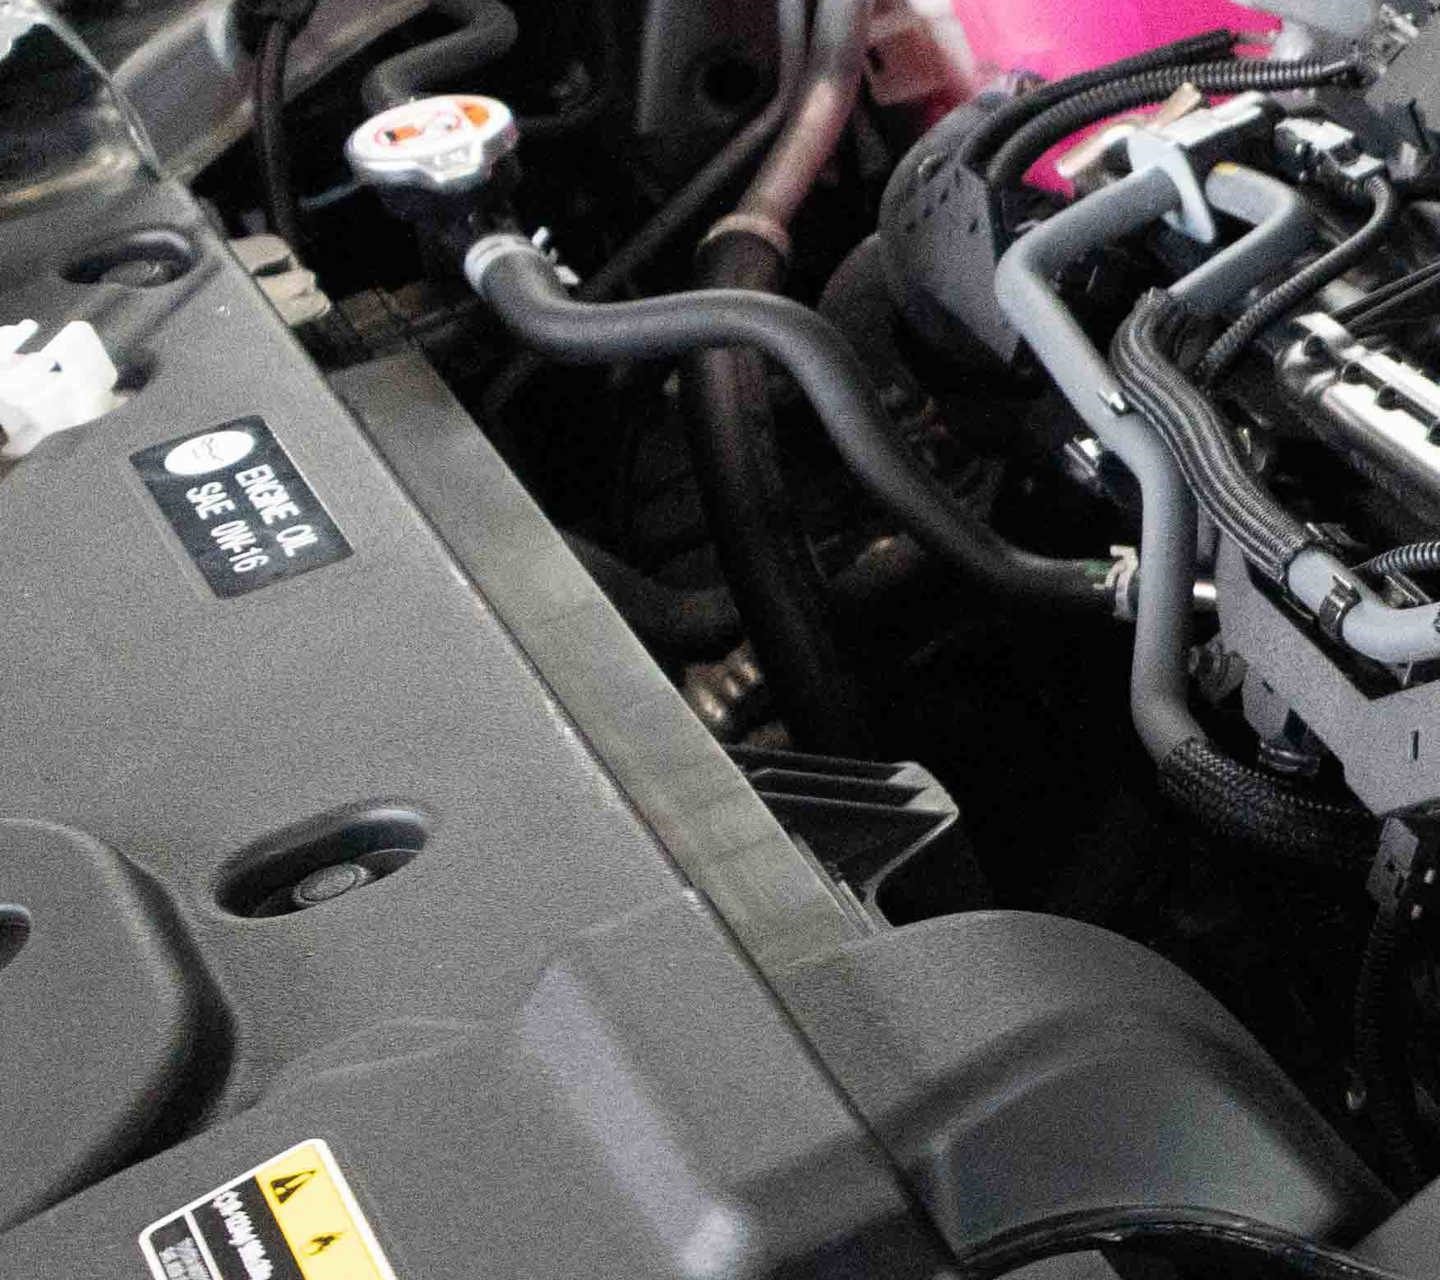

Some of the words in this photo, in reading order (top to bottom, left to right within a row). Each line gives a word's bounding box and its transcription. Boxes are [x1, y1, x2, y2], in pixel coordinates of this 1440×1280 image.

[185, 481, 235, 520] SAE
[210, 519, 270, 573] 0W-16
[235, 463, 300, 525] ENGINE
[275, 523, 318, 558] OIL
